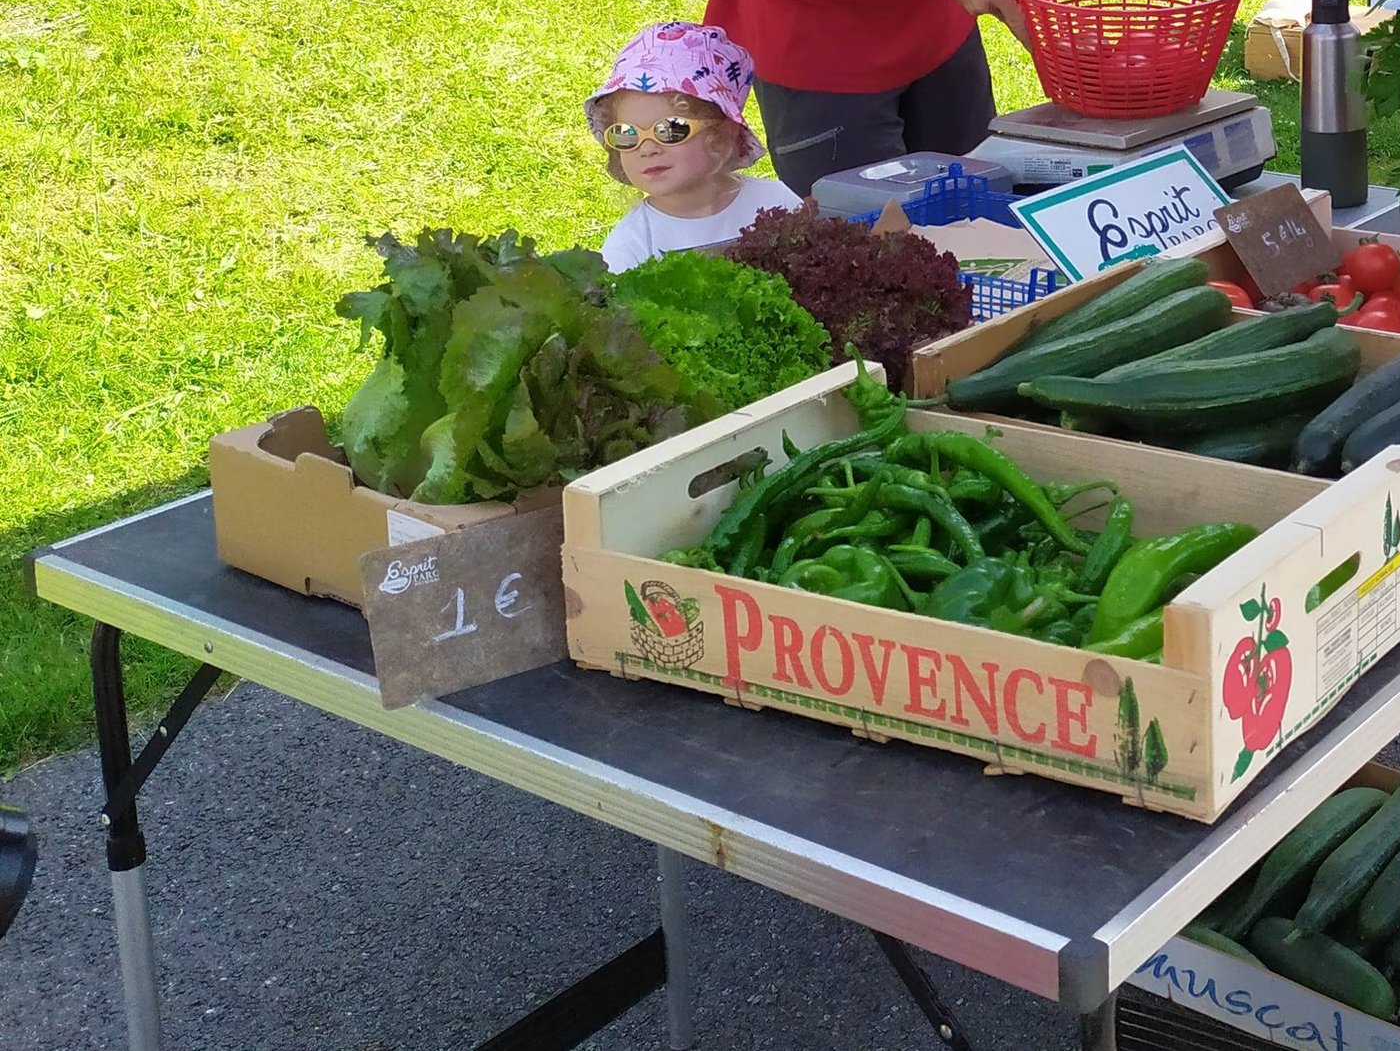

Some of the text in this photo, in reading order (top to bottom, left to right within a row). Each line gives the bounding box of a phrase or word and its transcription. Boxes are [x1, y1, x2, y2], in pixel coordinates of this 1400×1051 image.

[1087, 185, 1201, 263] Esprit
[1262, 231, 1281, 258] 5
[378, 555, 438, 595] Esprit
[413, 568, 440, 585] PARC
[432, 572, 533, 642] 1 €
[713, 583, 1099, 759] PROVENCE
[1135, 952, 1348, 1051] muscat
